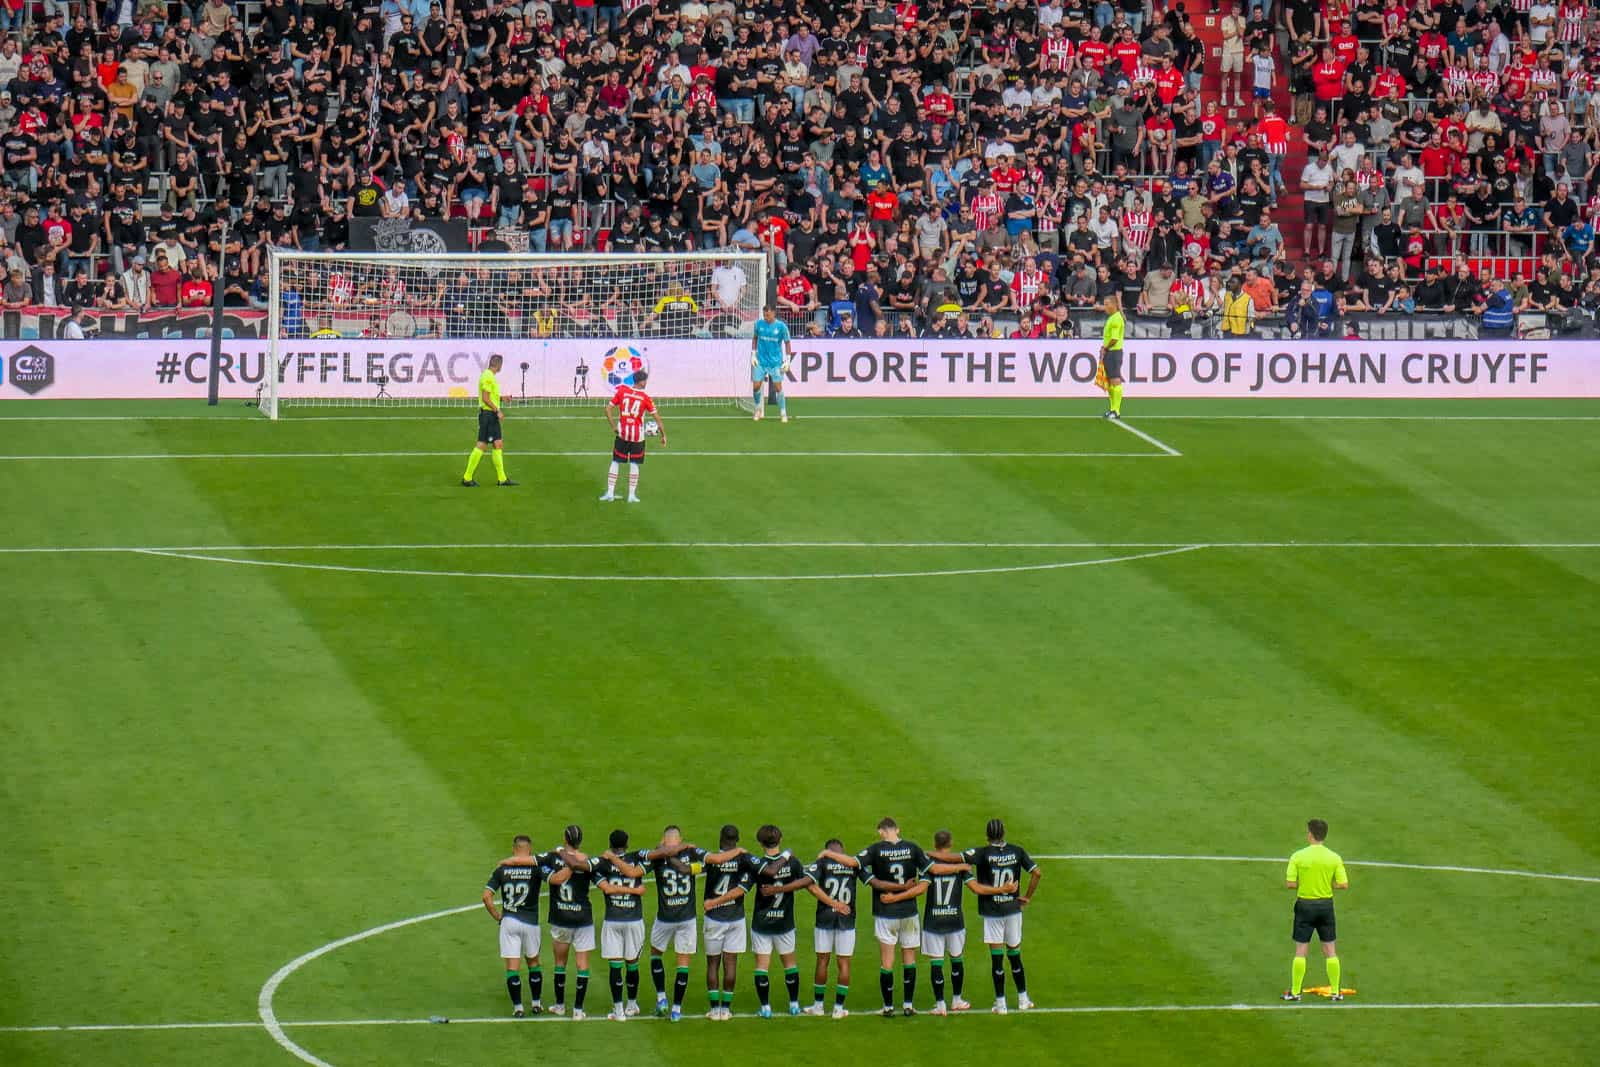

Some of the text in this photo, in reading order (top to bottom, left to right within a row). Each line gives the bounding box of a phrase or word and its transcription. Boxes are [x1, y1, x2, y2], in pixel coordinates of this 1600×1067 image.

[784, 352, 1548, 391] PLORE THE WOLD OF JOHAN CRUYFF
[622, 397, 641, 417] 14
[663, 869, 691, 896] 33
[714, 874, 730, 896] 4
[889, 863, 905, 885] 3
[992, 869, 1014, 891] 10
[503, 882, 529, 907] 32
[825, 877, 851, 904] 26
[934, 876, 956, 905] 17
